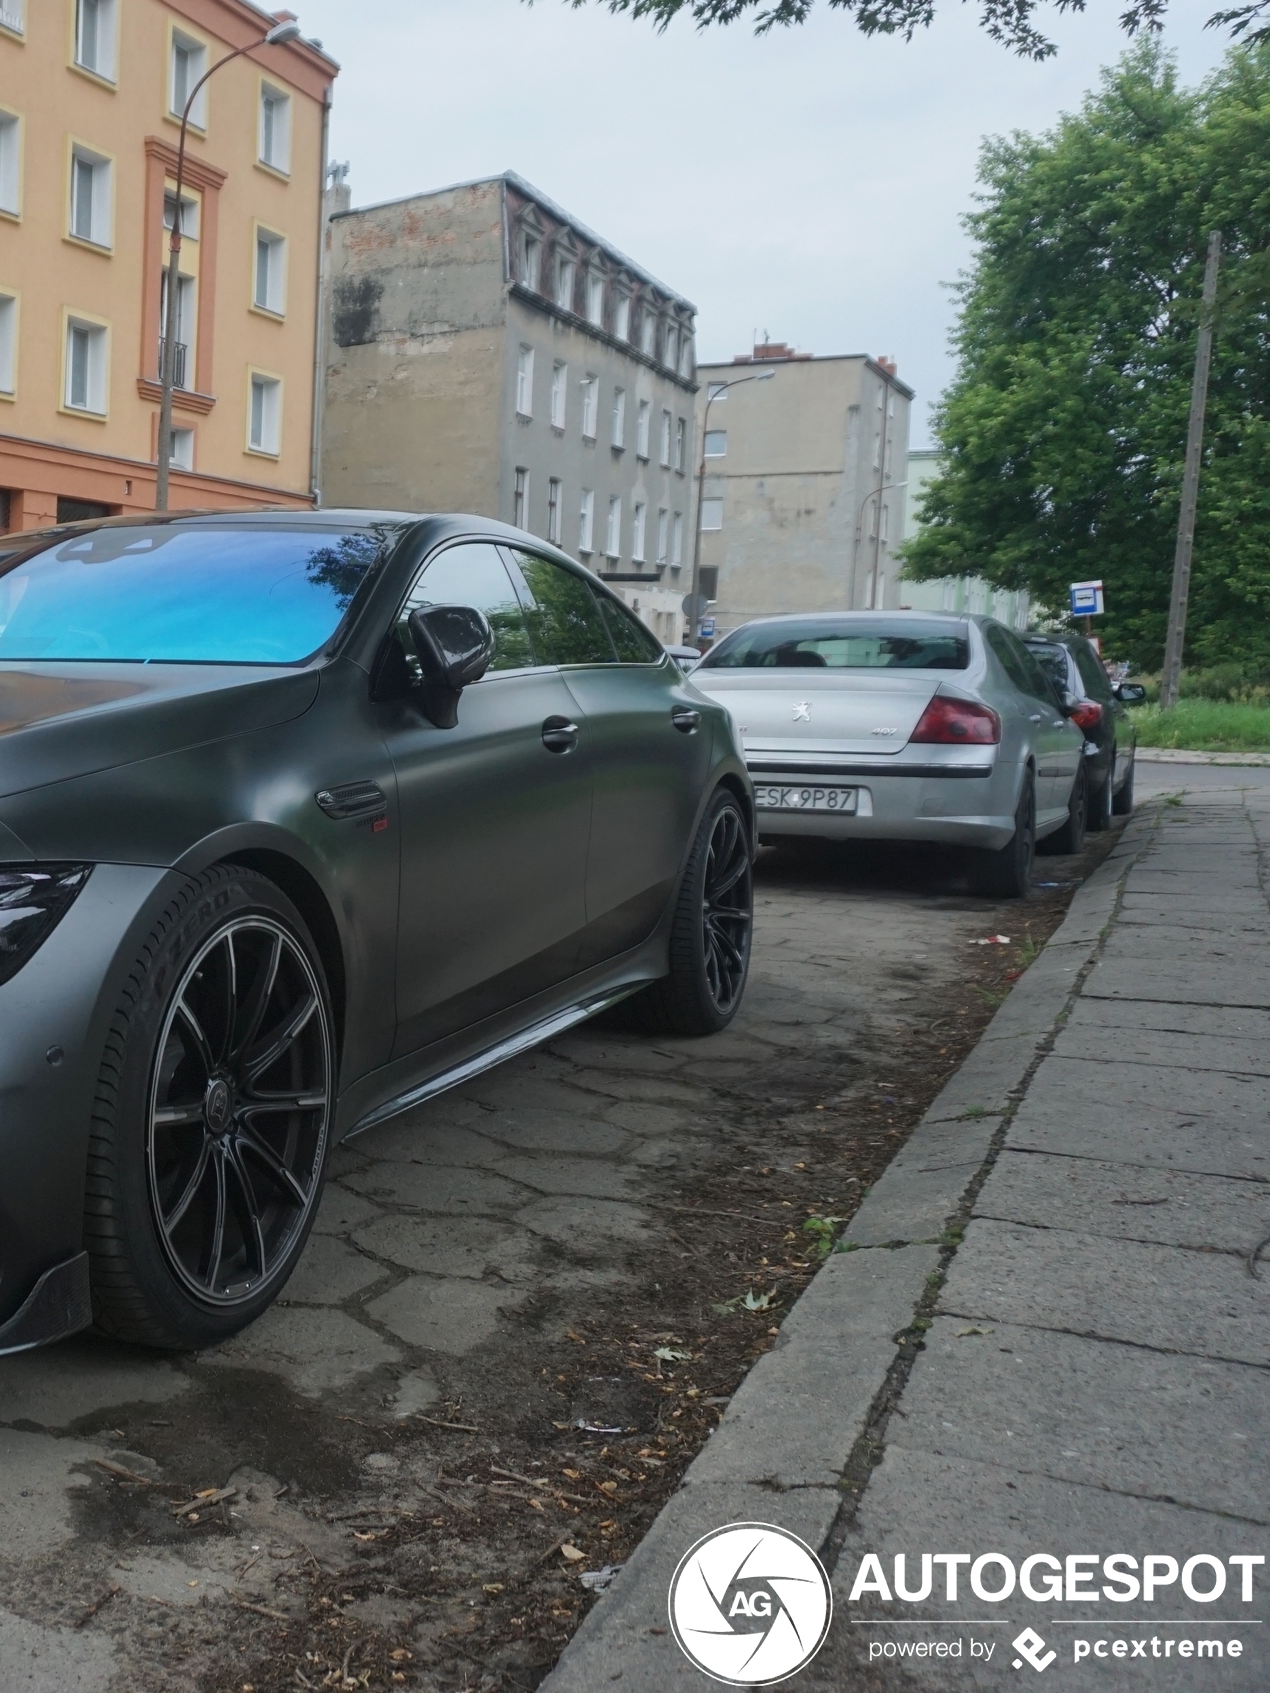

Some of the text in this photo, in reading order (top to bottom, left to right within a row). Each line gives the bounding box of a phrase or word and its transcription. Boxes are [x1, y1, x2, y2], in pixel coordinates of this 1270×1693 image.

[870, 727, 898, 736] 407
[755, 787, 853, 809] ESK 9P87
